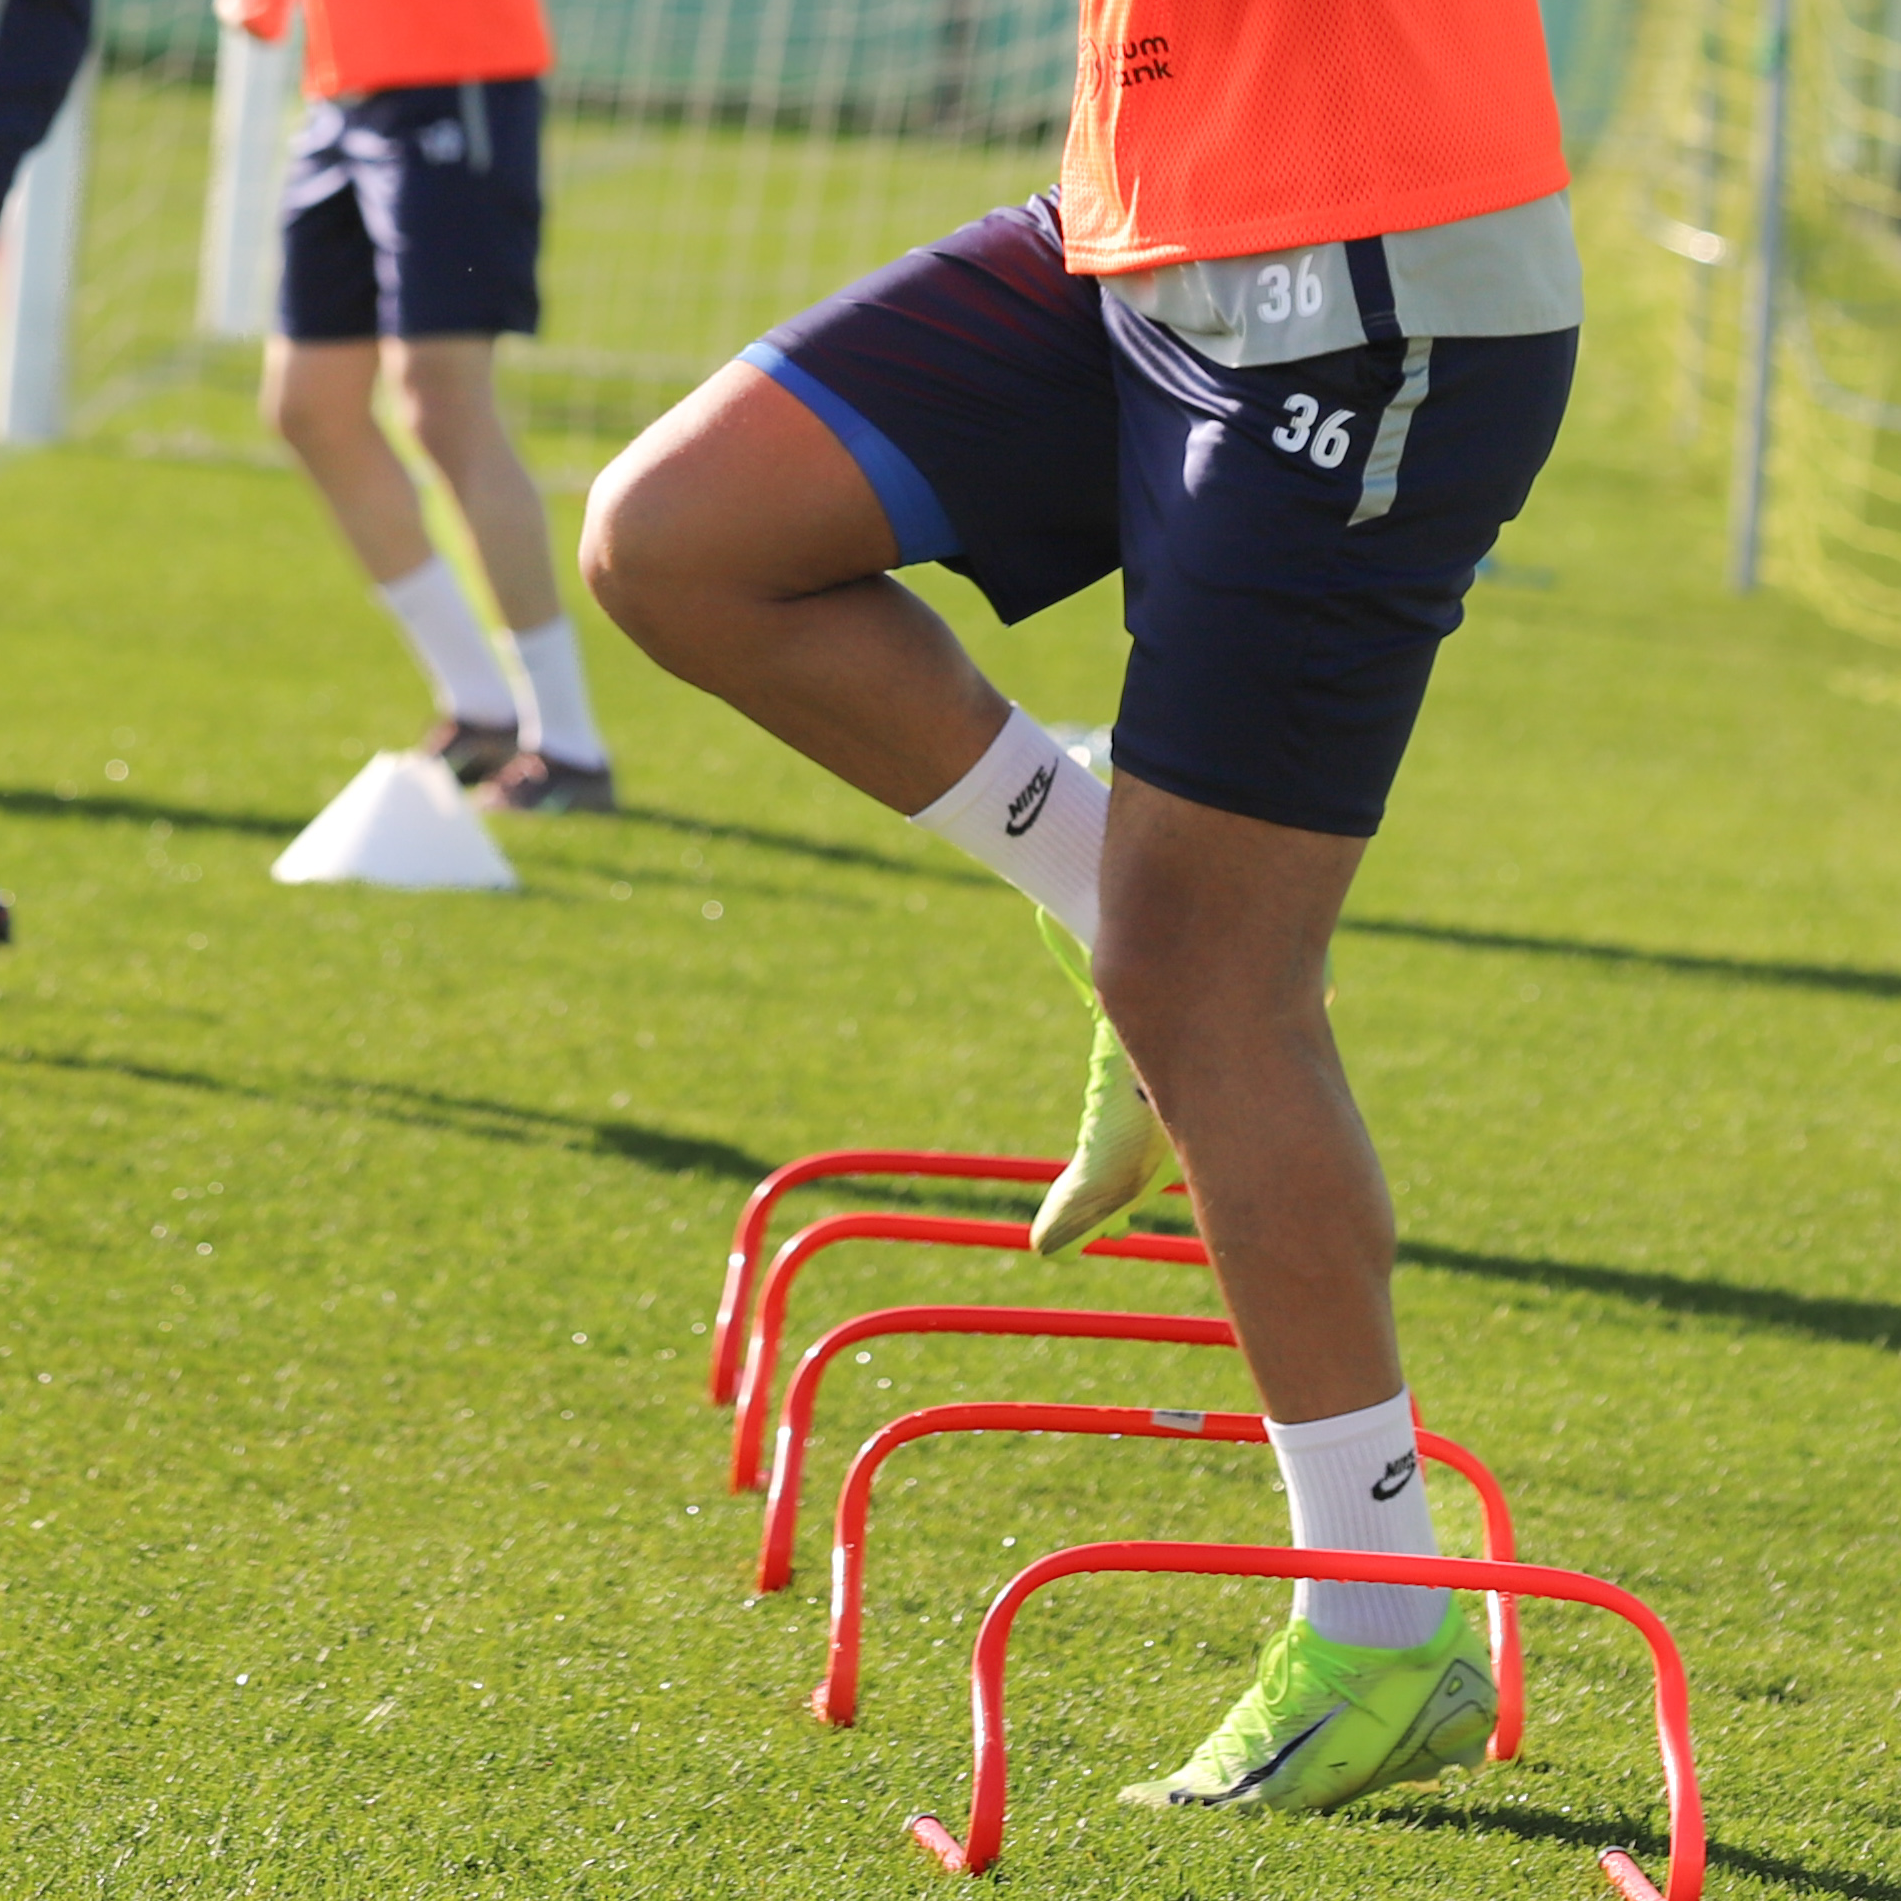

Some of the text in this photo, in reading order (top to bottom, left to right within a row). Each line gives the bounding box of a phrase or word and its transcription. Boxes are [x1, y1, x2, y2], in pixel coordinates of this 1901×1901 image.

[1257, 253, 1323, 324] 36
[1272, 392, 1357, 469] 36
[1008, 764, 1050, 820] NIKE
